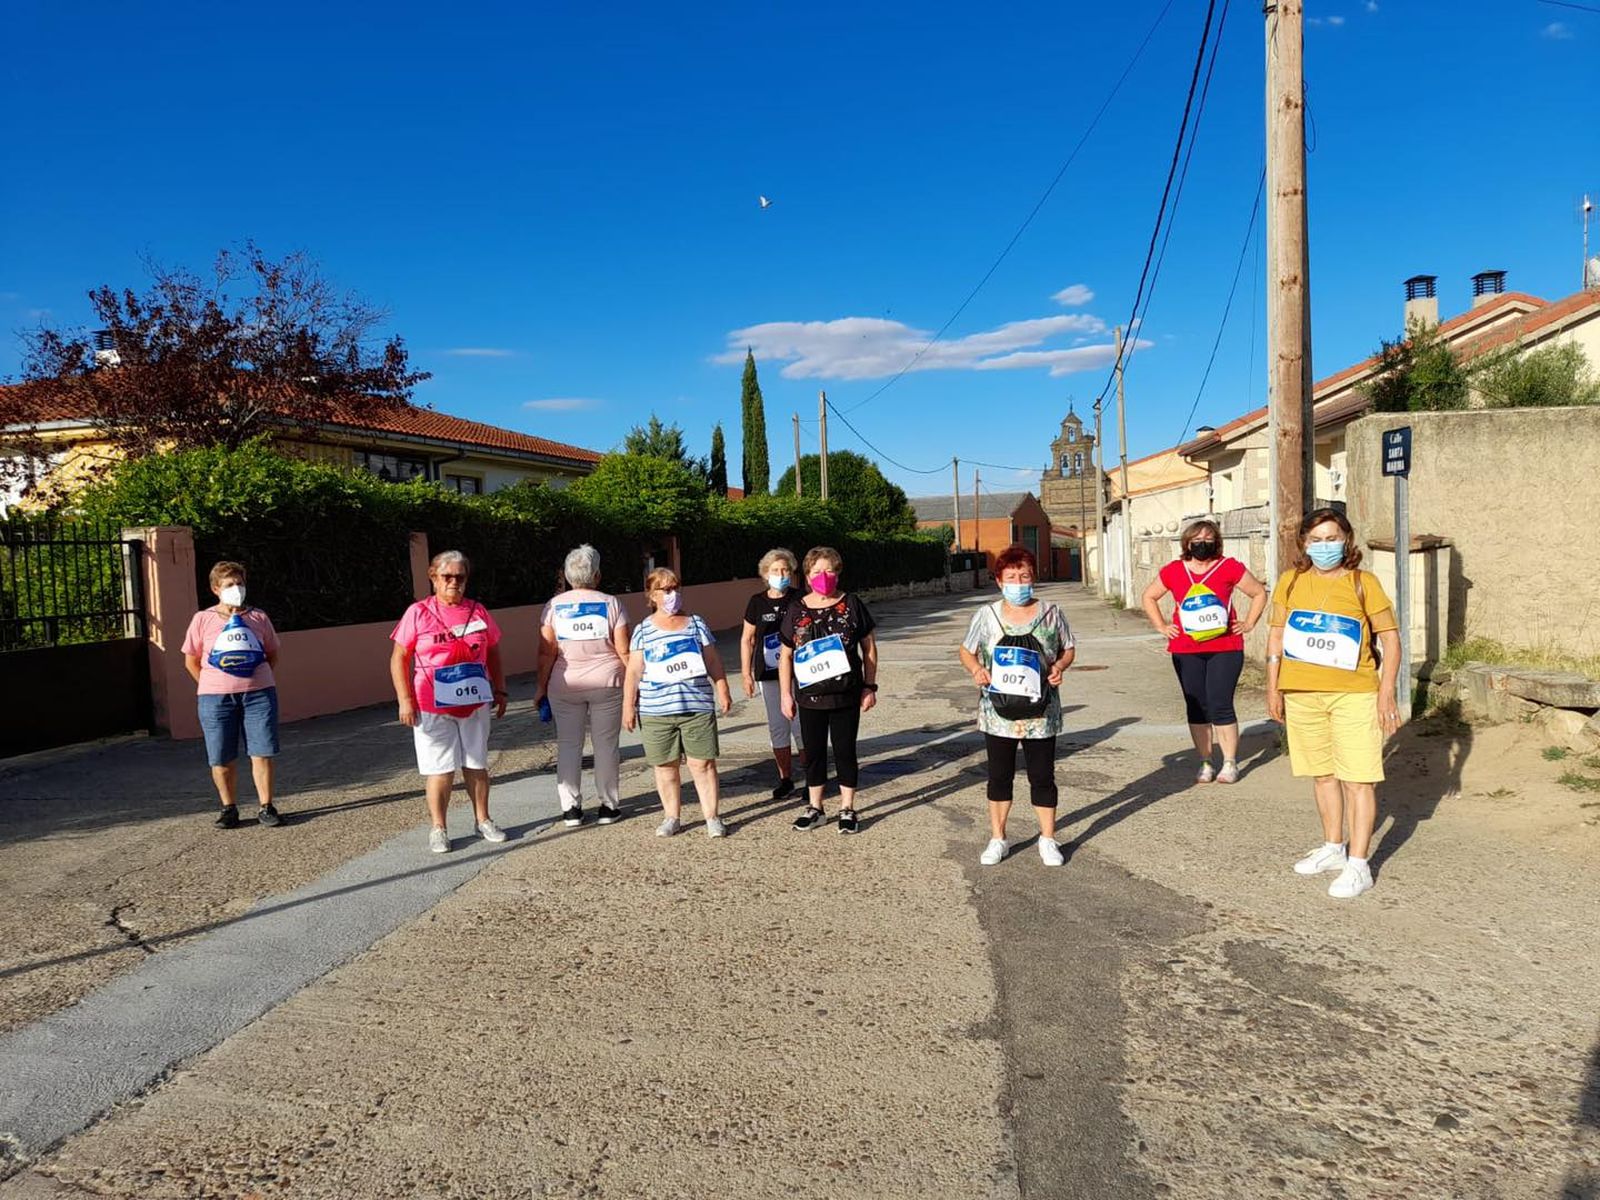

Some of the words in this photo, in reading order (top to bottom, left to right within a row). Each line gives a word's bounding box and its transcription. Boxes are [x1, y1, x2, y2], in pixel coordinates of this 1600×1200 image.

[1198, 612, 1219, 623] 005
[572, 622, 594, 632] 004
[227, 632, 249, 642] 003
[1306, 636, 1336, 651] 009
[666, 660, 688, 674] 008
[809, 660, 831, 674] 001
[1002, 673, 1026, 685] 007
[455, 685, 479, 697] 016
